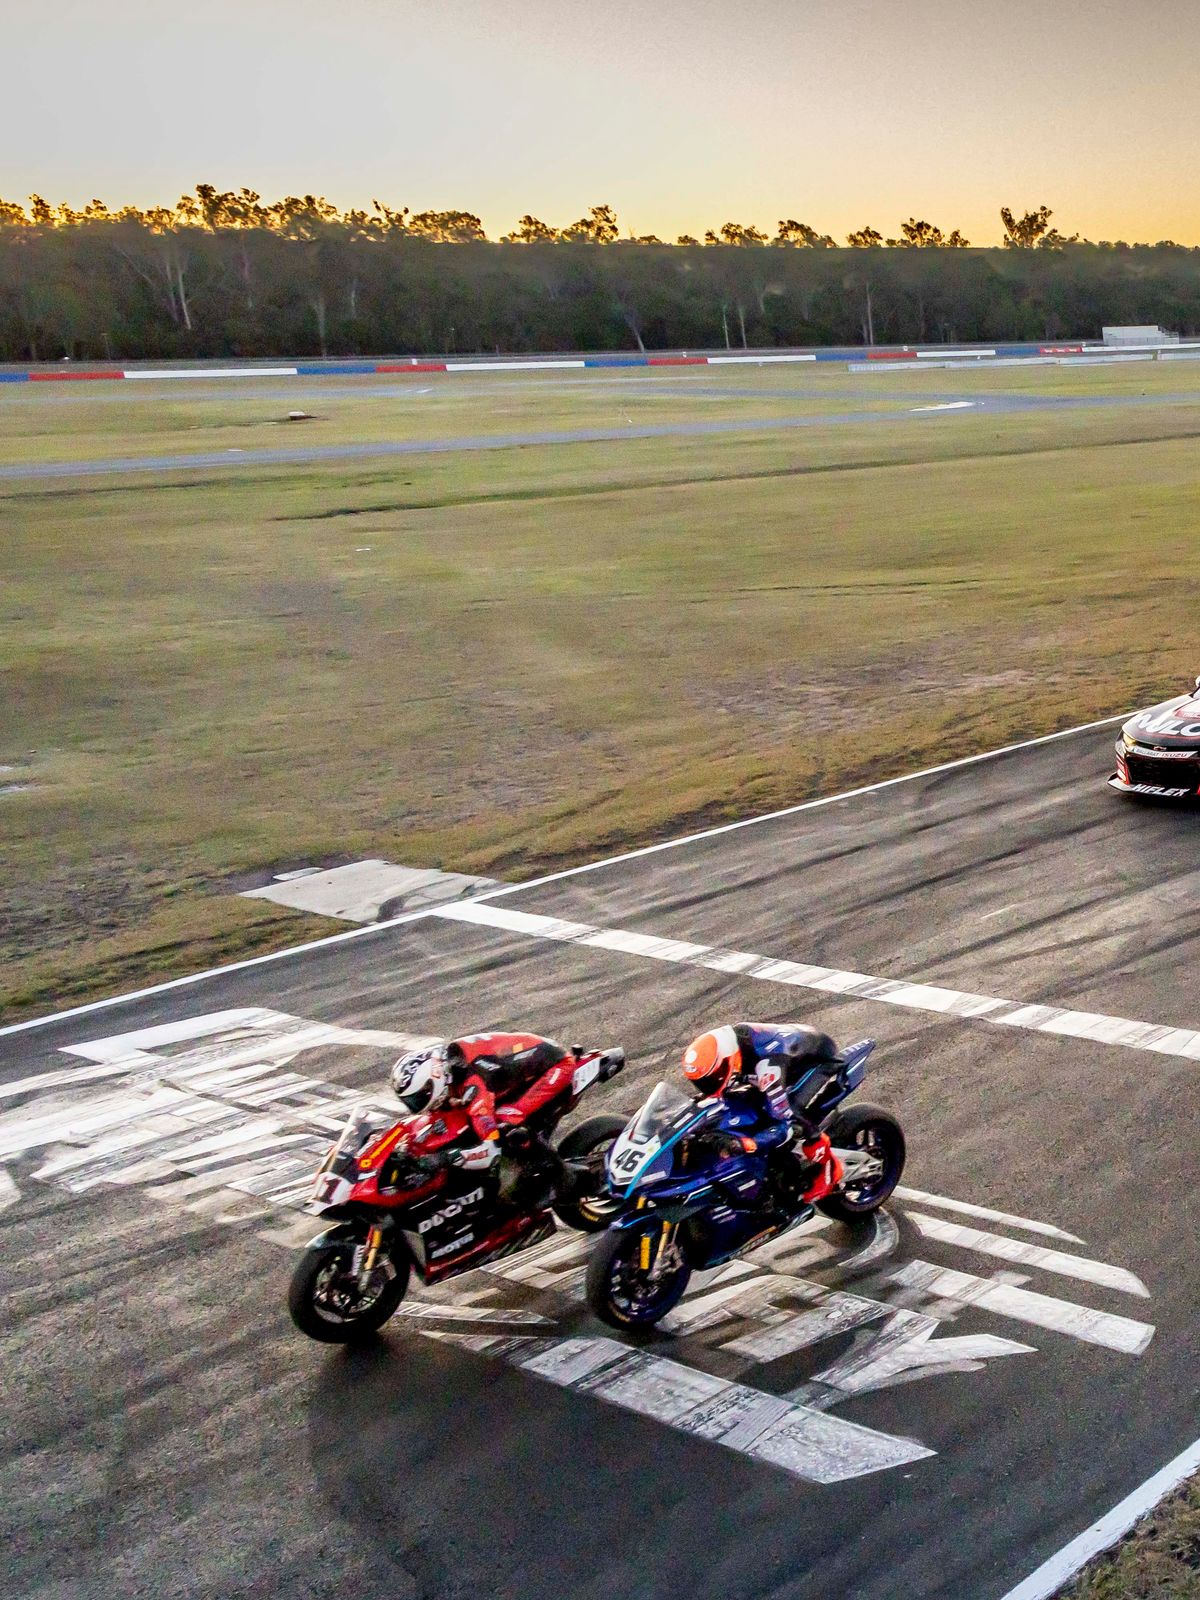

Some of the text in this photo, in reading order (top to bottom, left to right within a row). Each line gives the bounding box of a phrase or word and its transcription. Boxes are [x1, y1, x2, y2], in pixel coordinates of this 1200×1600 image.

[1132, 783, 1191, 797] HIFLEX
[613, 1148, 646, 1173] 46
[319, 1176, 342, 1205] 1
